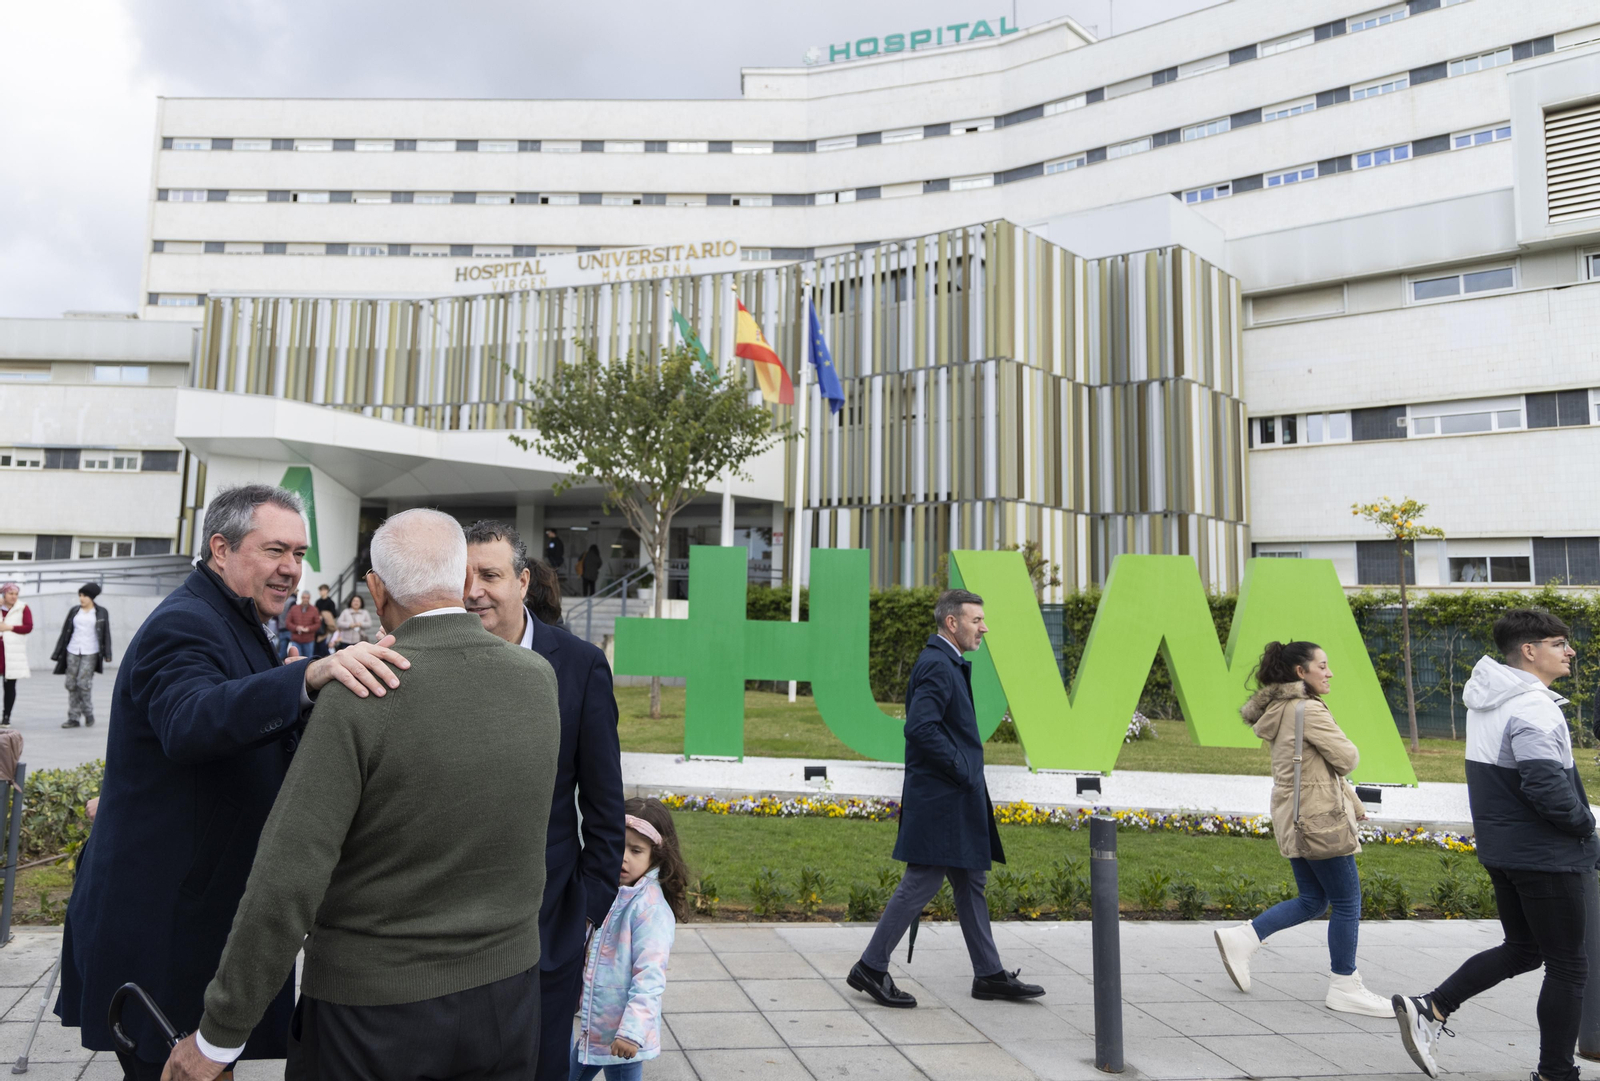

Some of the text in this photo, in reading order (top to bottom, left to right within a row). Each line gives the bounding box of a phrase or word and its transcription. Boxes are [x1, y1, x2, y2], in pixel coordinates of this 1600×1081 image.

[829, 16, 1019, 62] HOSPITAL
[455, 240, 737, 282] HOSPITAL UNIVERSITARIO
[491, 264, 692, 291] VIRGEN MACARENA
